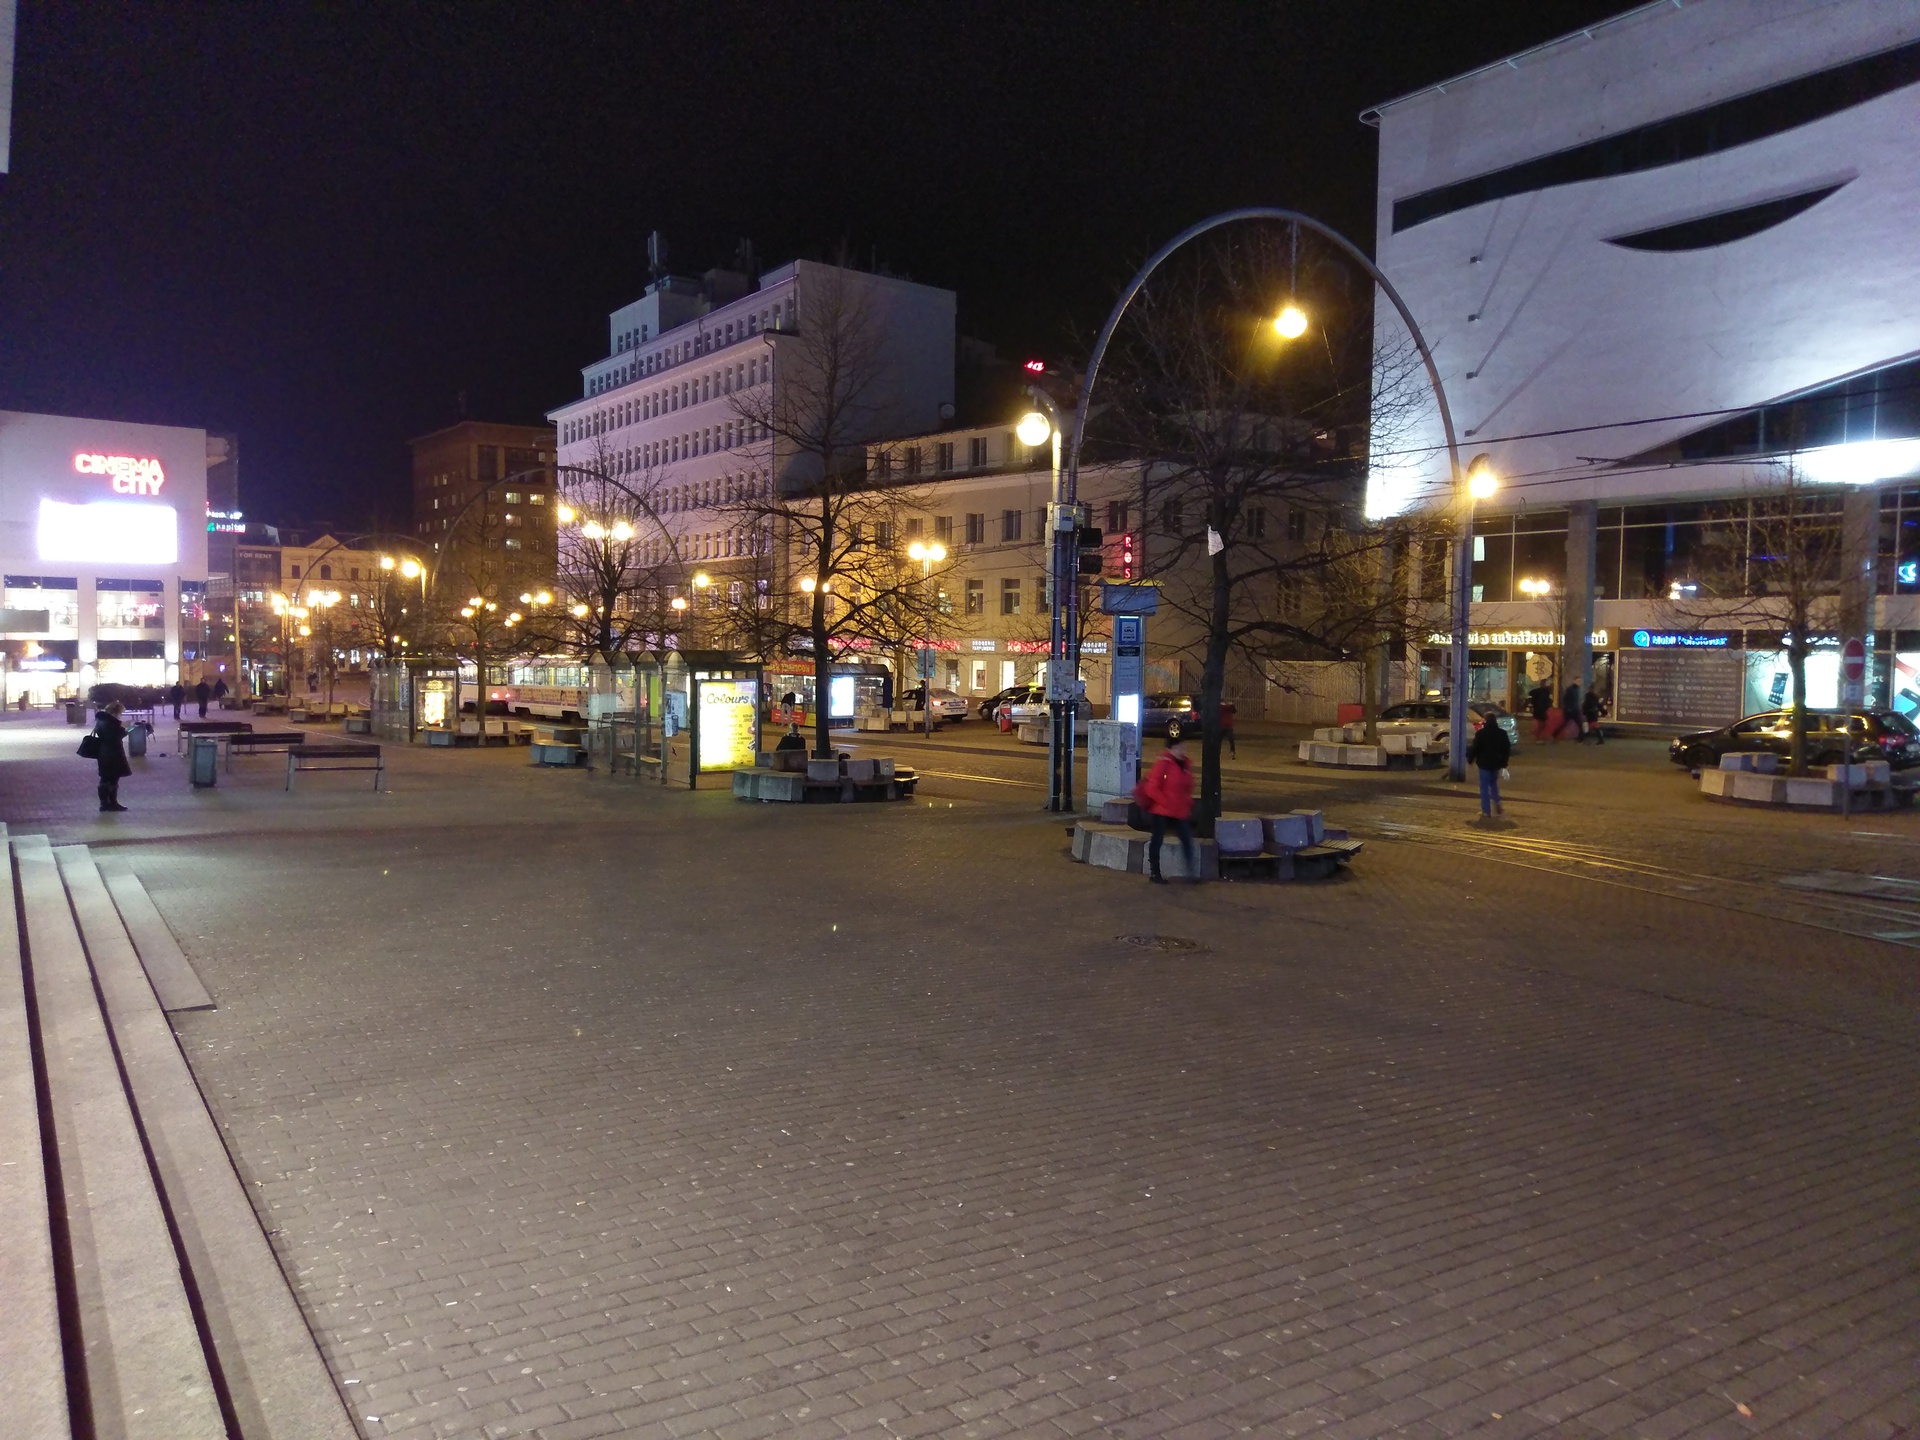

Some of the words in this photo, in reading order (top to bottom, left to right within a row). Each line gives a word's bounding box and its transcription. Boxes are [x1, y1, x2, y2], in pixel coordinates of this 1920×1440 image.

[75, 453, 163, 476] CINEMA
[112, 474, 165, 496] CITY
[254, 552, 273, 560] RENT
[1652, 635, 1677, 645] Mobil
[706, 693, 750, 704] Colours
